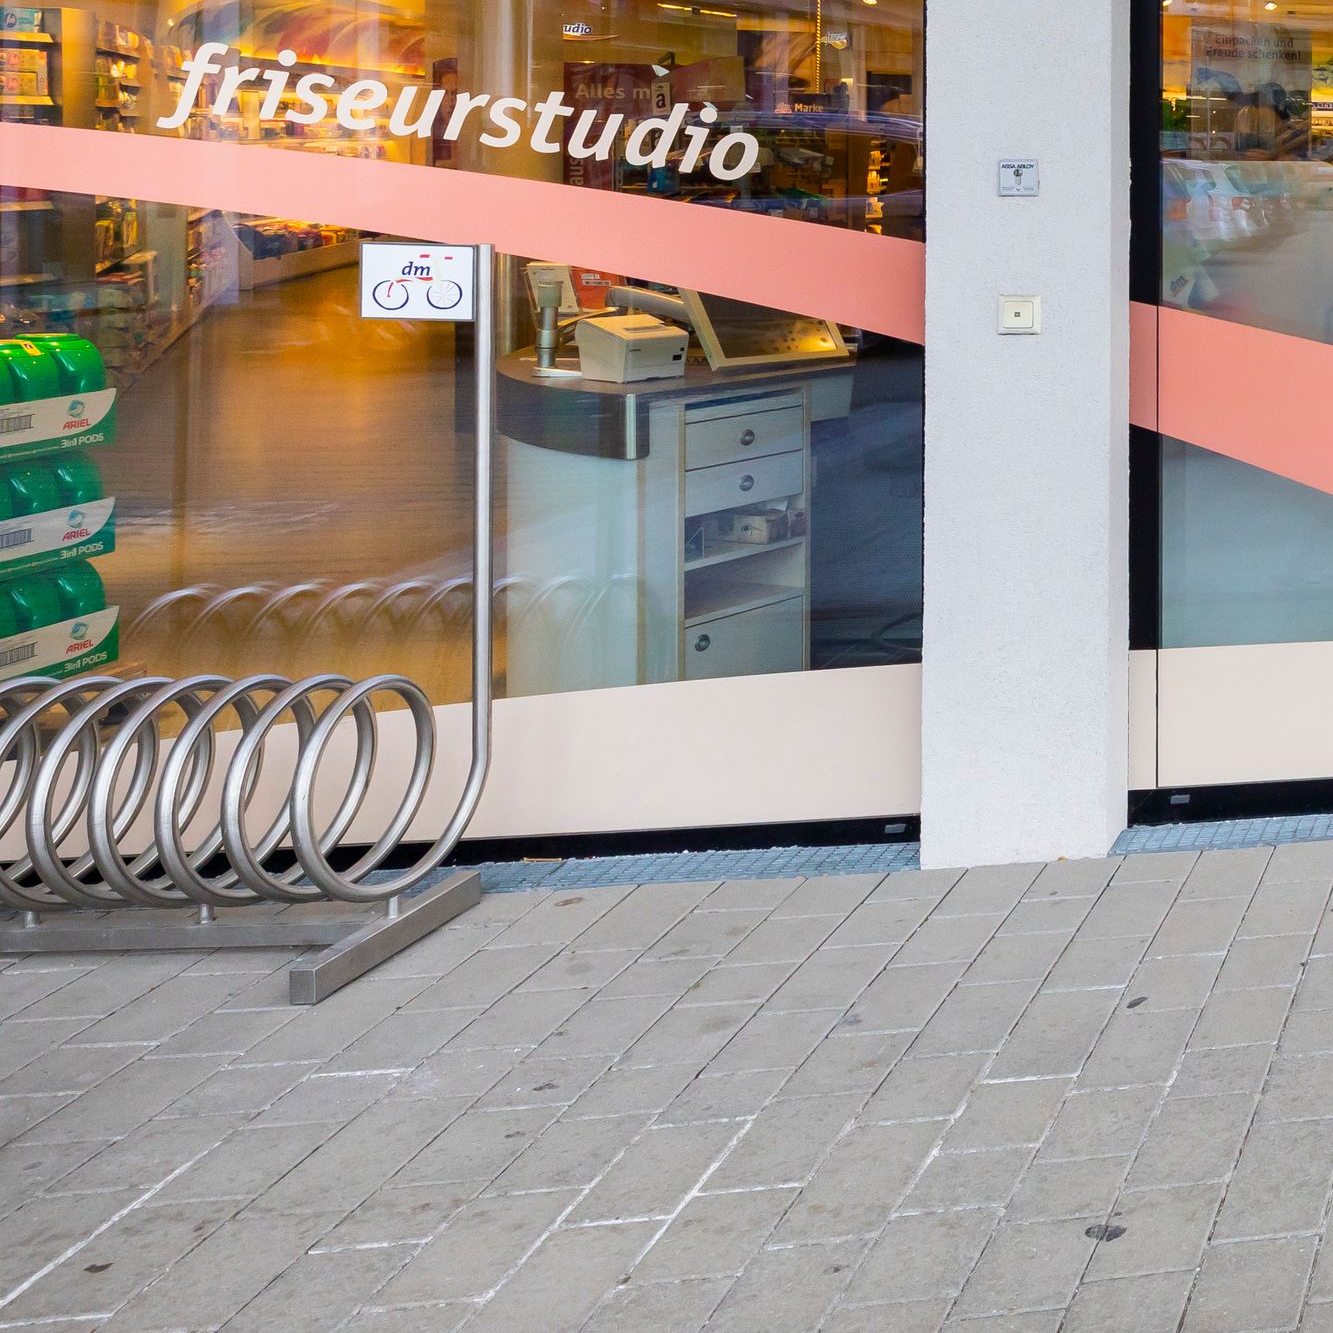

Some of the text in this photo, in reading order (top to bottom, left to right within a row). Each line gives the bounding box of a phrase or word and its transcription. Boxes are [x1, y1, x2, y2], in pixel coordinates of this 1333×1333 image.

[575, 82, 650, 100] Alles m
[156, 41, 760, 182] friseurstudio
[794, 102, 823, 113] Marke
[402, 260, 431, 277] dm
[62, 417, 92, 431] ARIEL
[78, 432, 104, 446] PODS
[62, 526, 91, 542] ARIEL
[77, 541, 104, 555] PODS
[65, 638, 95, 655] ARIEL
[81, 651, 108, 667] PODS
